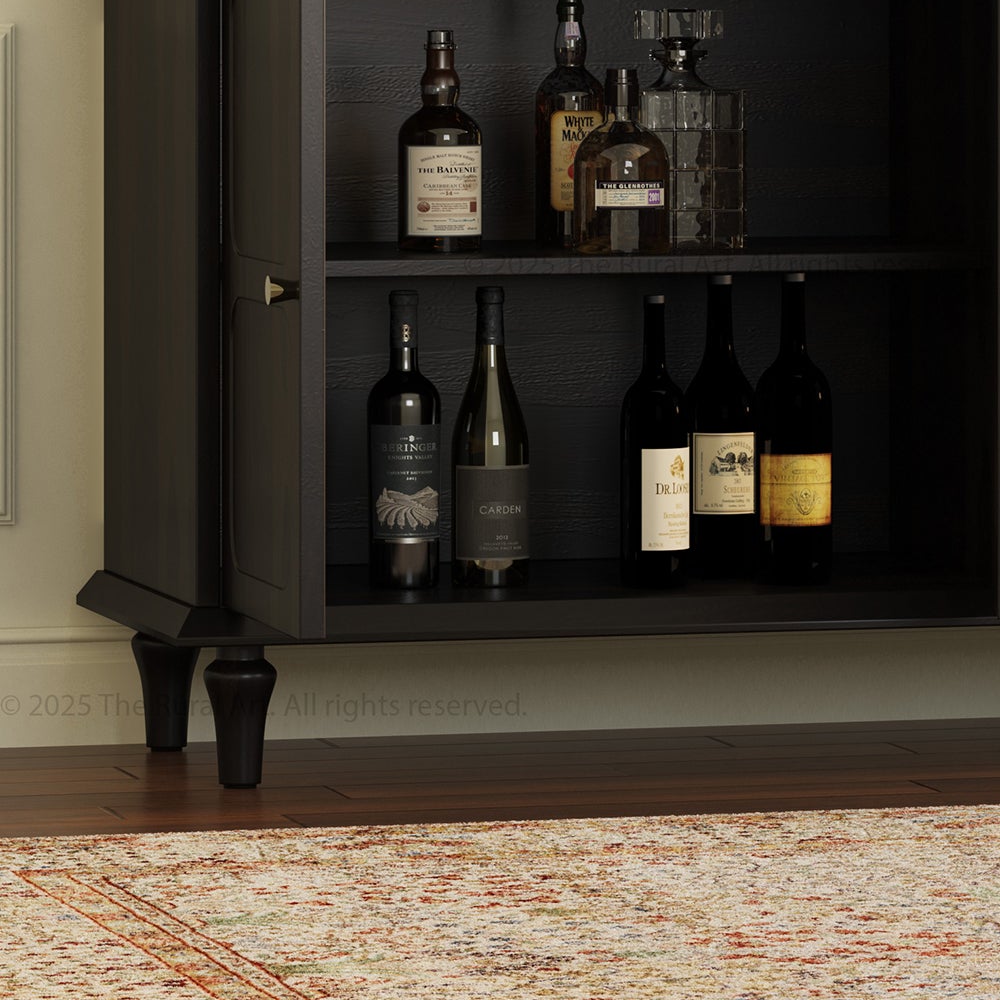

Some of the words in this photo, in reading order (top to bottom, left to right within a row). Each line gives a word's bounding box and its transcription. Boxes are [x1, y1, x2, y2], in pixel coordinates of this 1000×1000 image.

[564, 115, 594, 127] WHYTE
[382, 442, 437, 452] BERINGER
[479, 505, 522, 515] CARDEN
